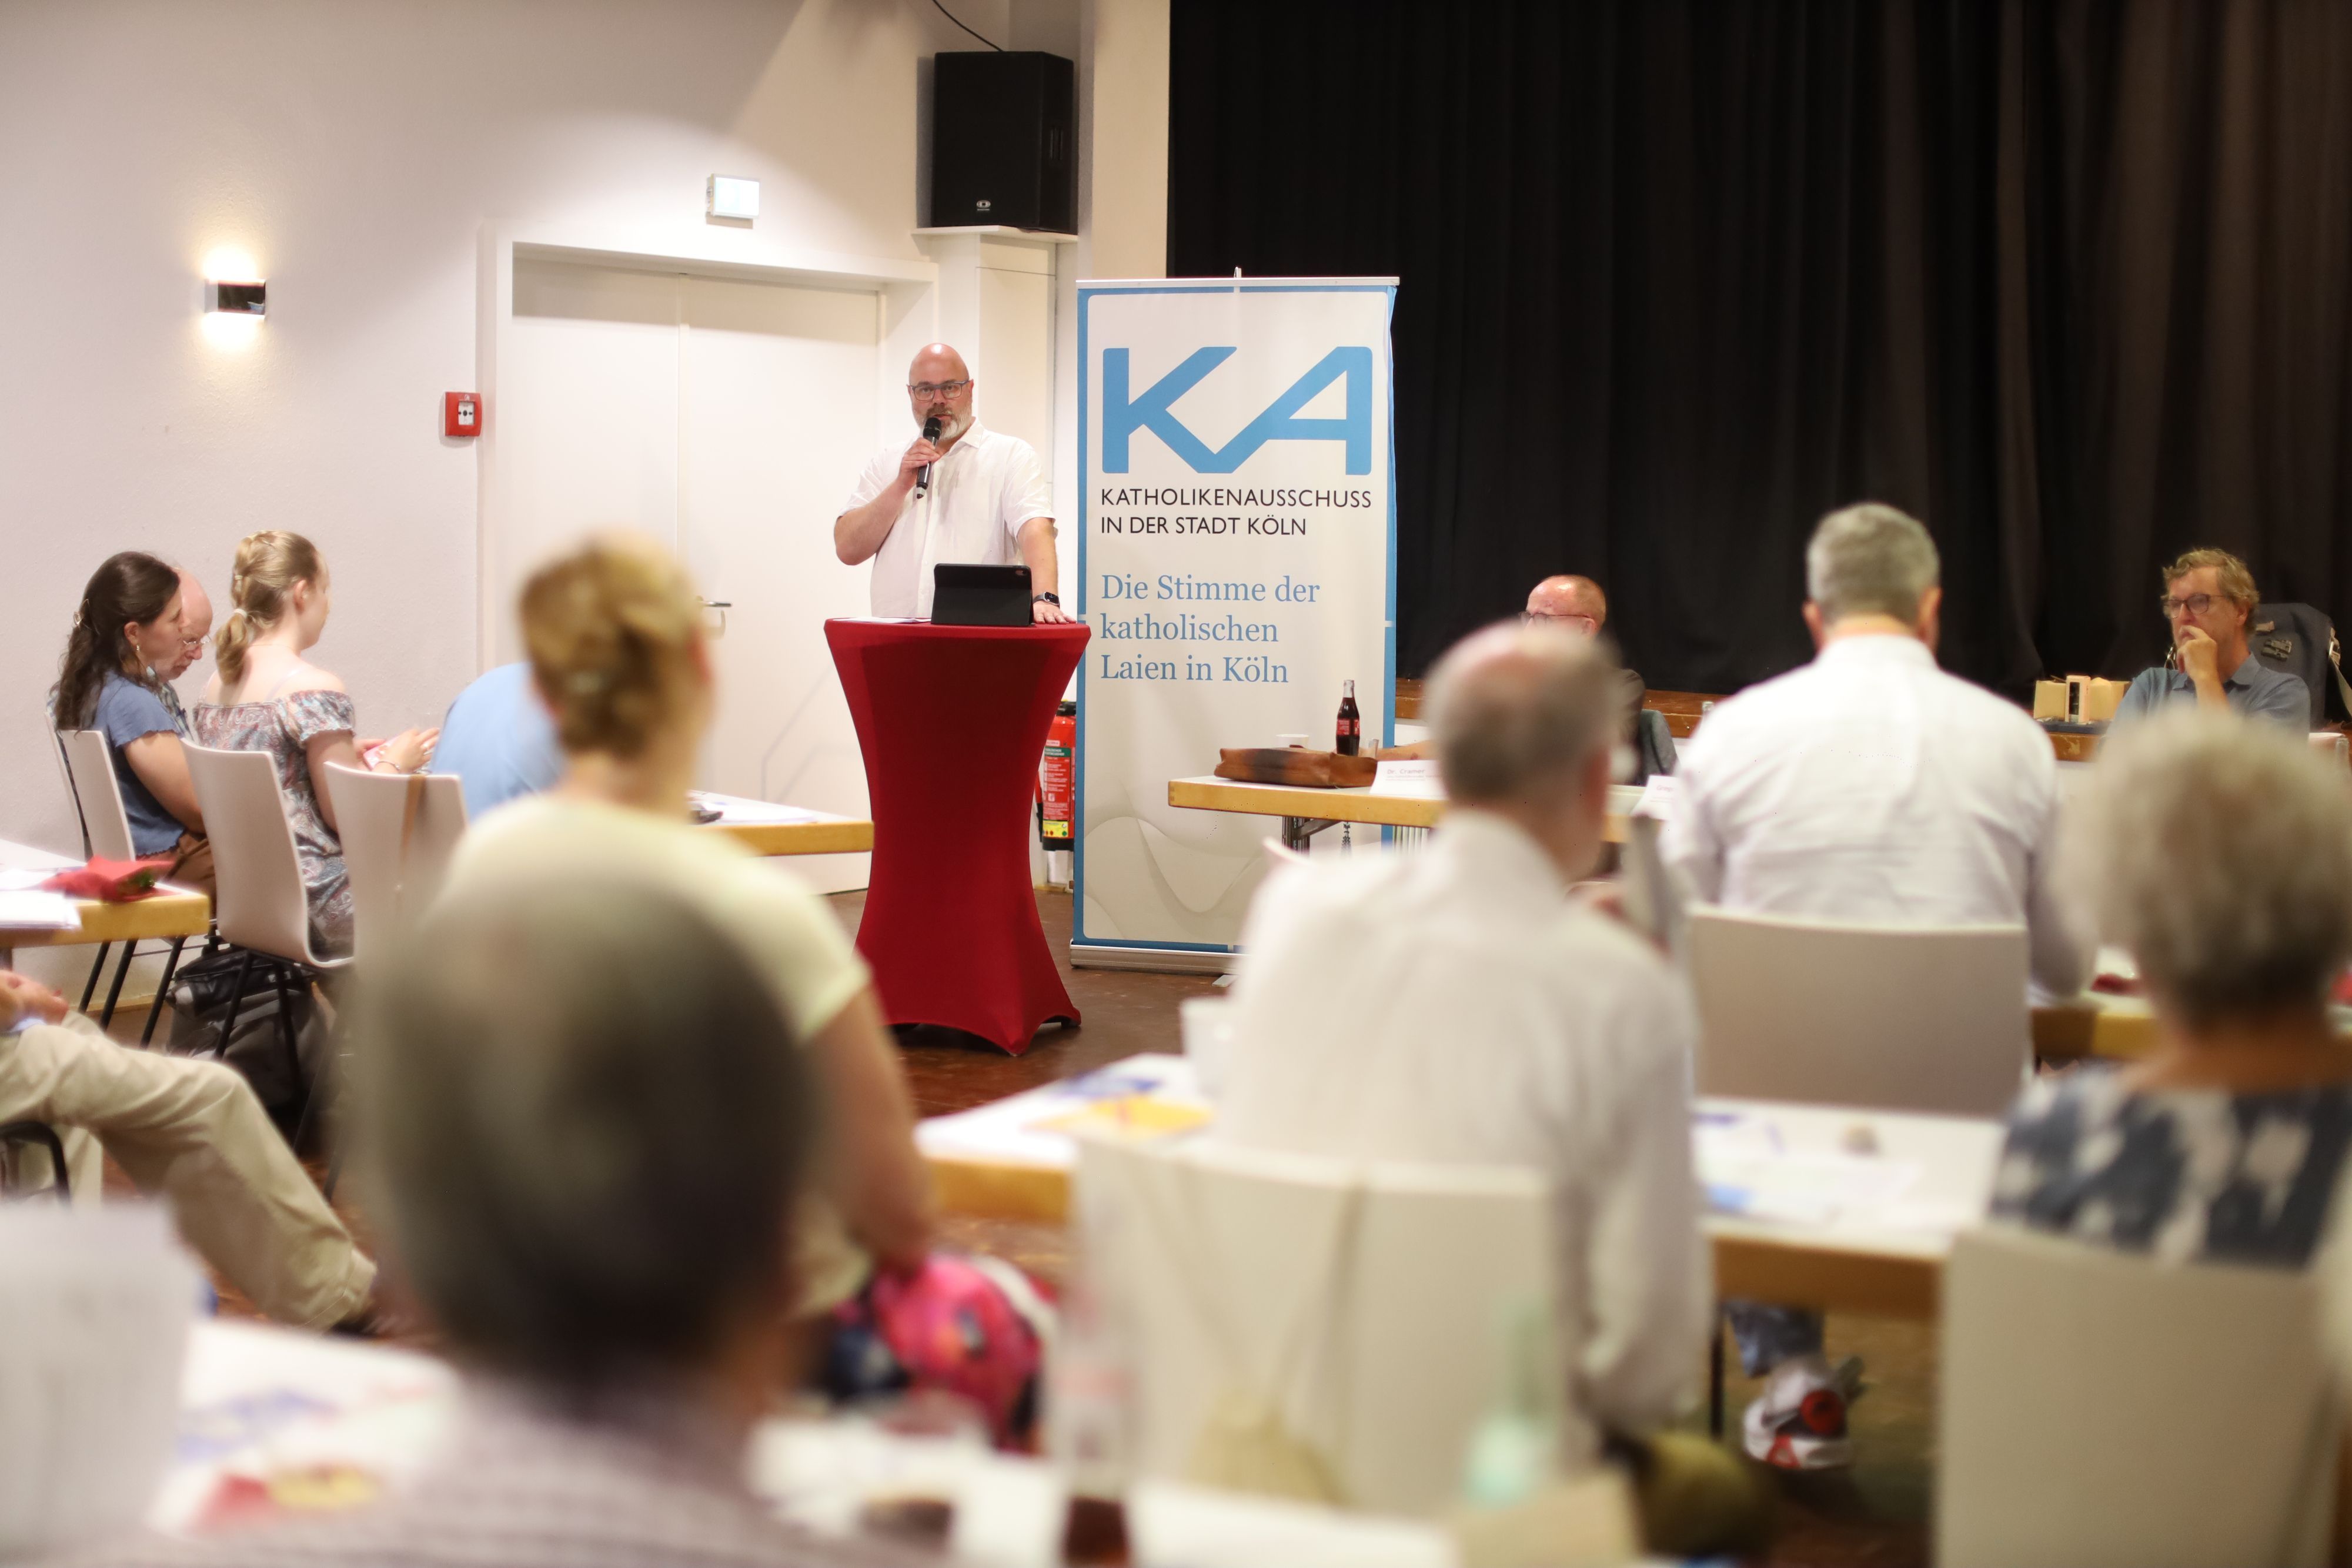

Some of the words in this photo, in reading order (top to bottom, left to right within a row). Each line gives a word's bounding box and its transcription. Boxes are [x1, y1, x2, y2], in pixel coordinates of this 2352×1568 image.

[1102, 347, 1372, 475] KA
[1102, 489, 1371, 508] KATHOLIKENAUSSCHUSS
[1102, 517, 1122, 533] IN
[1131, 517, 1169, 533] DER
[1176, 517, 1240, 534] STADT
[1248, 515, 1306, 535] KÖLN
[1102, 574, 1148, 599] Die
[1158, 574, 1265, 601] Stimme
[1275, 576, 1320, 602] der
[1100, 613, 1278, 641] katholischen
[1101, 654, 1177, 680] Laien
[1186, 655, 1213, 680] in
[1223, 656, 1289, 683] Köln
